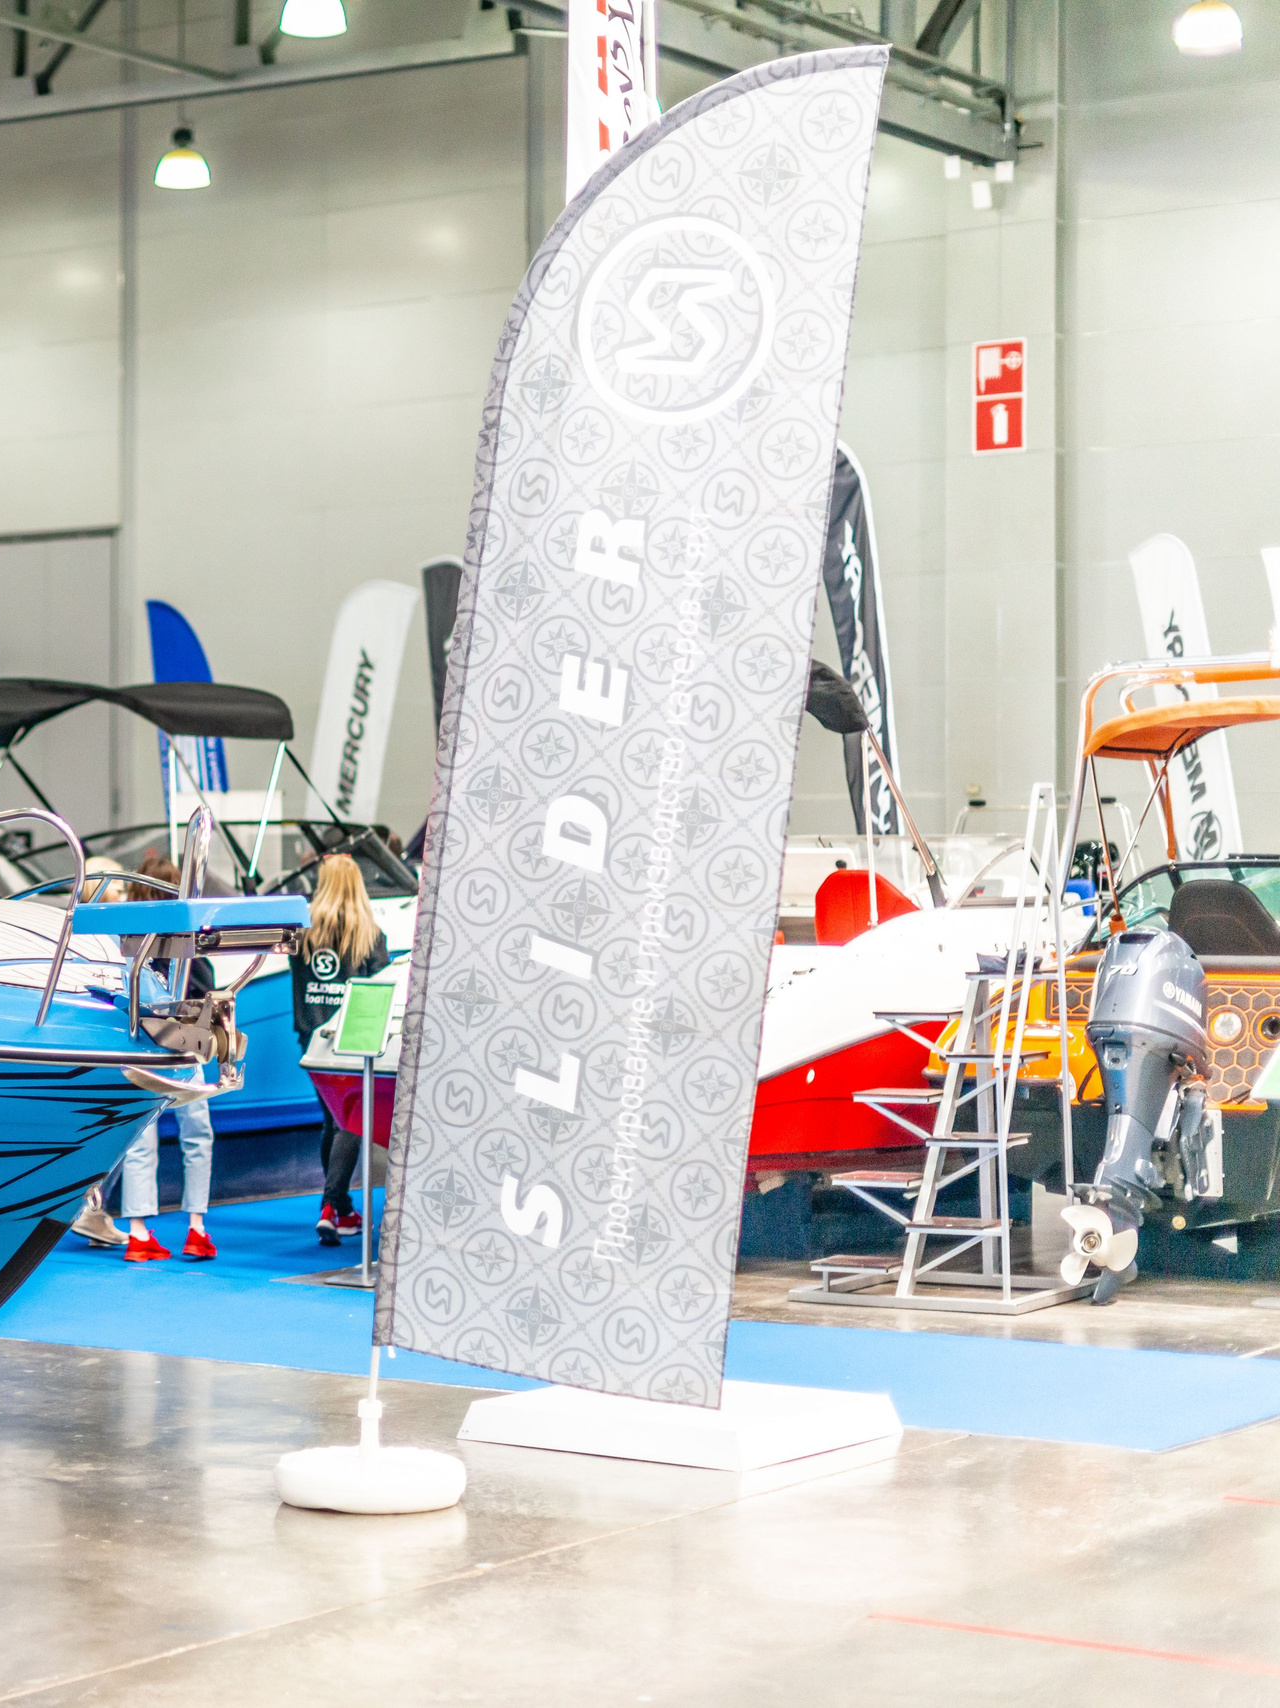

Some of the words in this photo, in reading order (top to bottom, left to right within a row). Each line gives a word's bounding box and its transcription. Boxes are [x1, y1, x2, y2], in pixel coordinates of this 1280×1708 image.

[682, 570, 705, 587] и
[687, 506, 712, 558] яхт
[335, 646, 376, 816] MERCURY
[668, 600, 704, 726] катеров
[501, 508, 646, 1248] SLIDER
[638, 738, 686, 957] производство
[635, 969, 658, 986] и
[593, 998, 656, 1262] Проектирование
